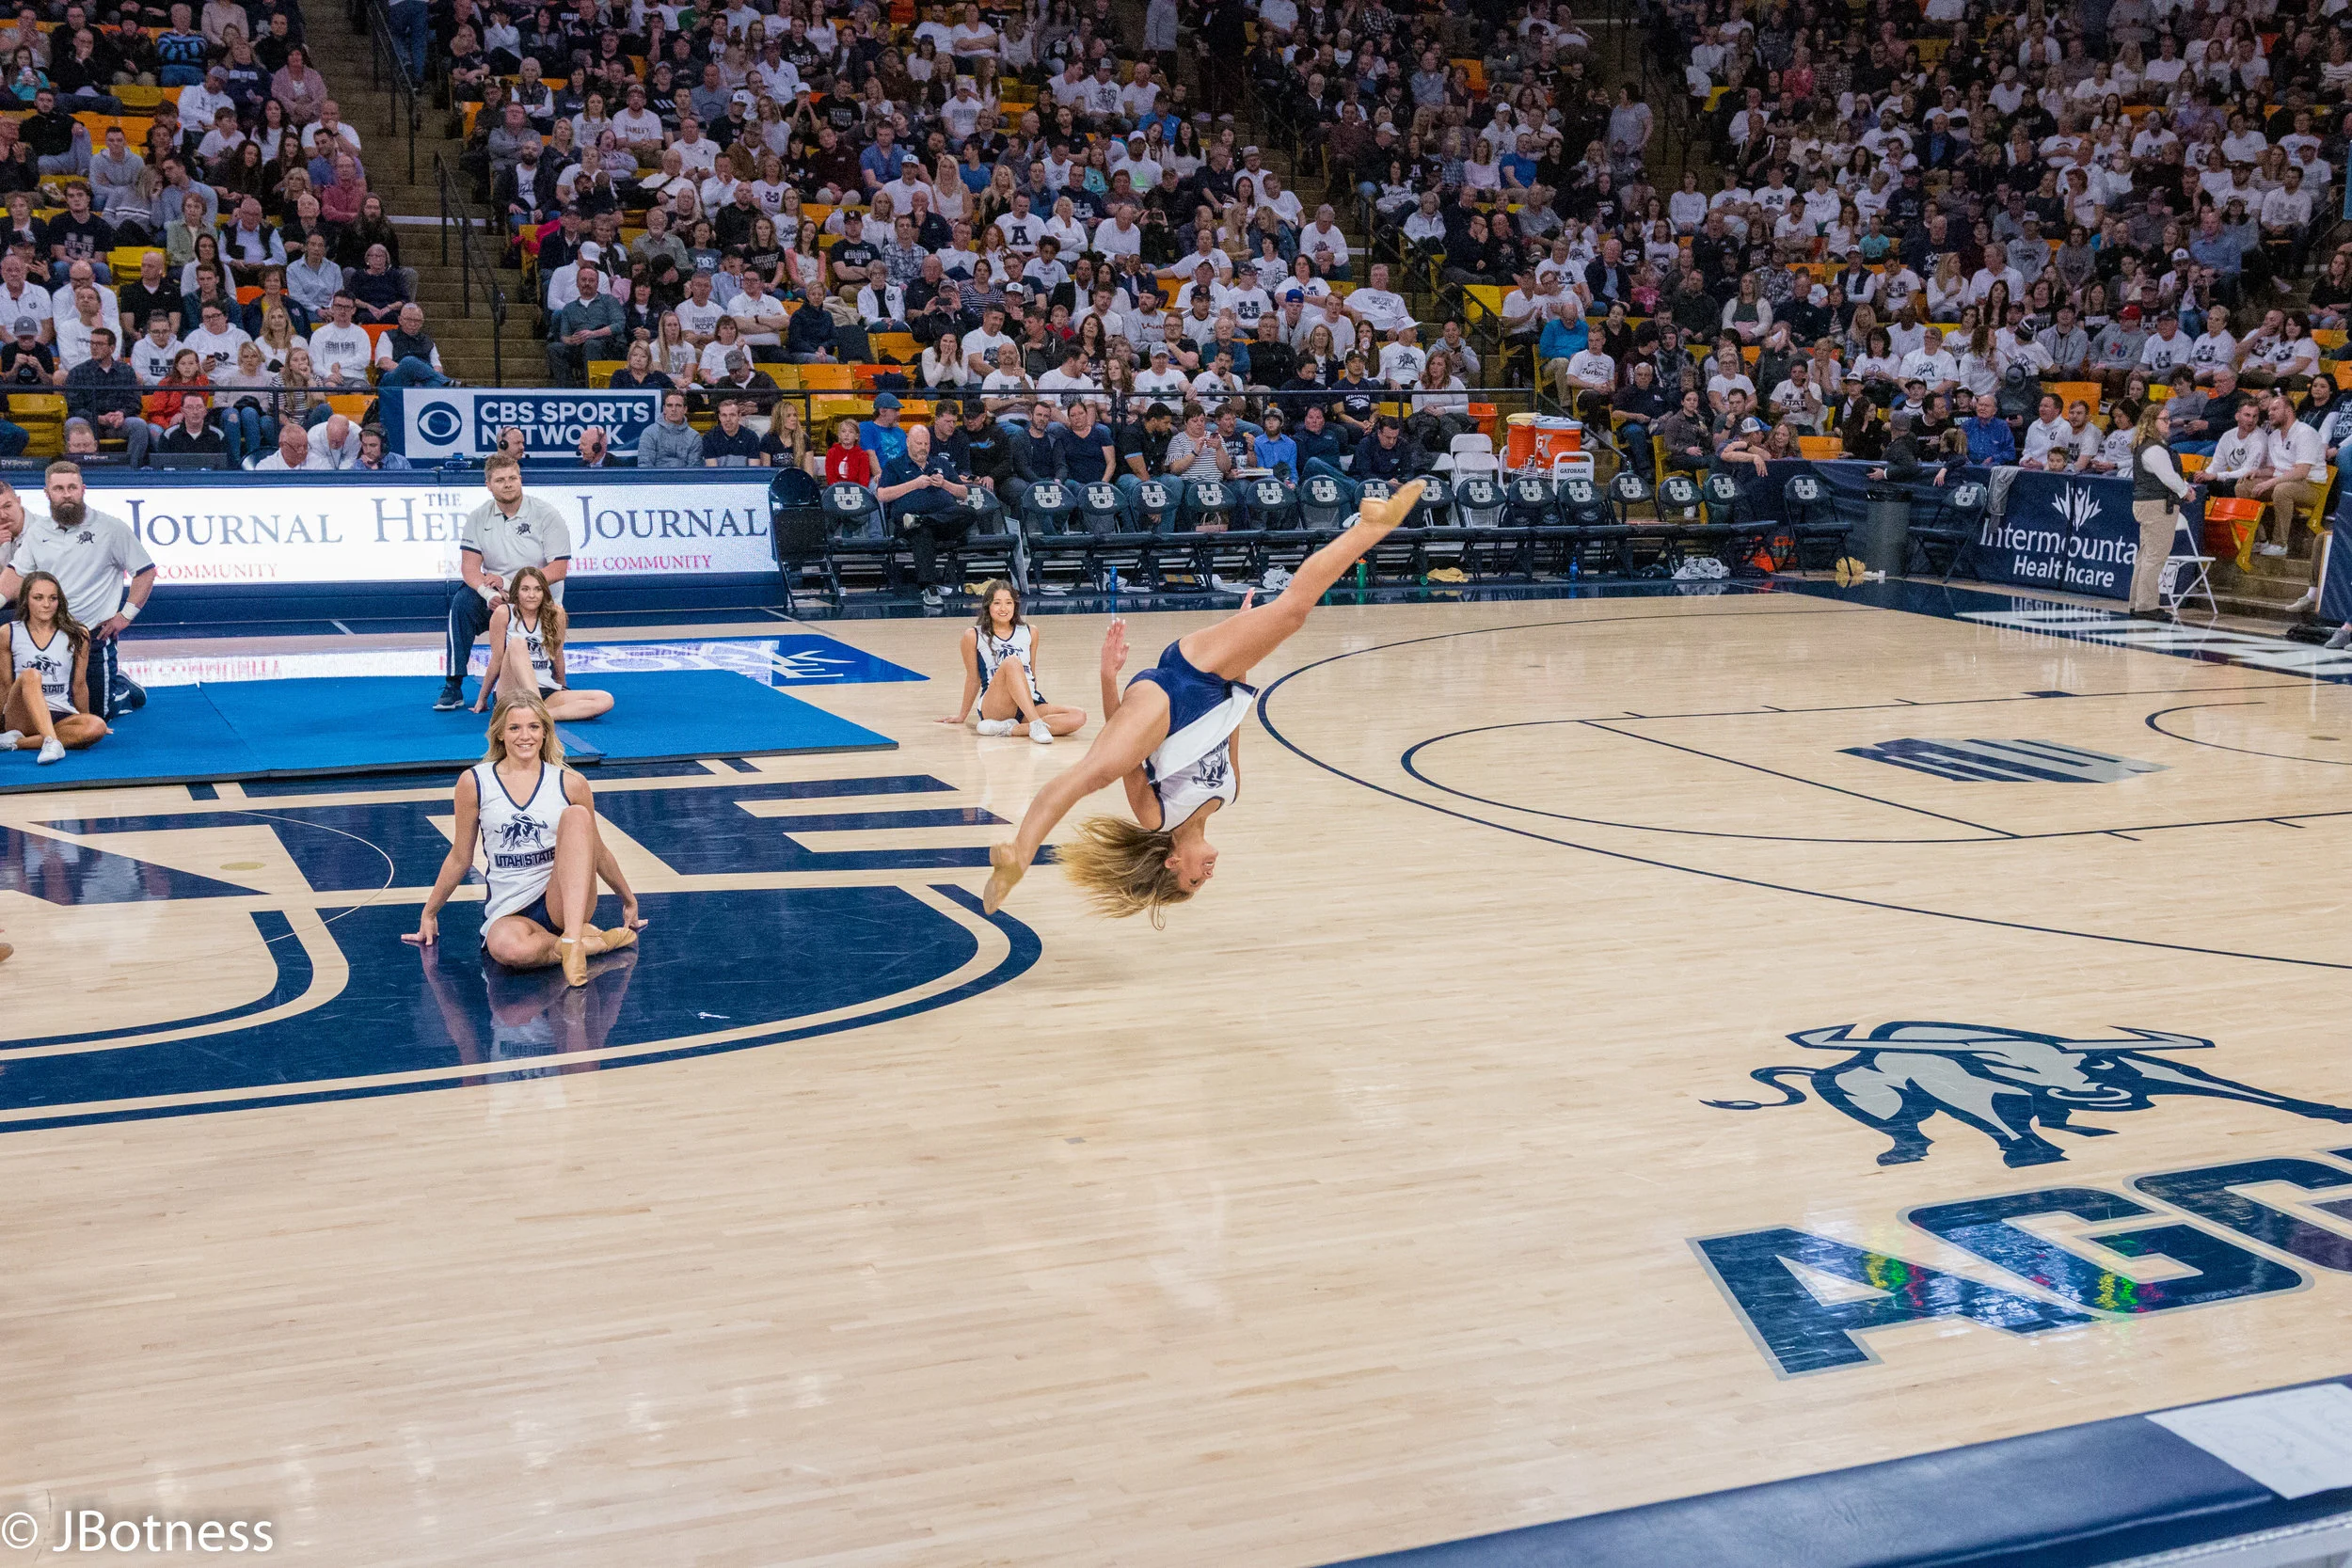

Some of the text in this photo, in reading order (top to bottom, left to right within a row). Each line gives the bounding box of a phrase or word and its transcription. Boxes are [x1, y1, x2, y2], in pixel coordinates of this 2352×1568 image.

[1011, 226, 1031, 245] A
[481, 402, 650, 423] CBS SPORTS
[425, 493, 461, 506] THE
[125, 499, 343, 546] JOURNAL
[576, 496, 768, 549] JOURNAL
[1979, 517, 2138, 564] Intermounta
[154, 562, 278, 579] COMMUNITY
[602, 555, 712, 571] COMMUNITY
[2013, 555, 2115, 587] Healthcare
[41, 684, 65, 693] STATE
[495, 853, 525, 868] UTAH
[1686, 1146, 2352, 1380] AGG
